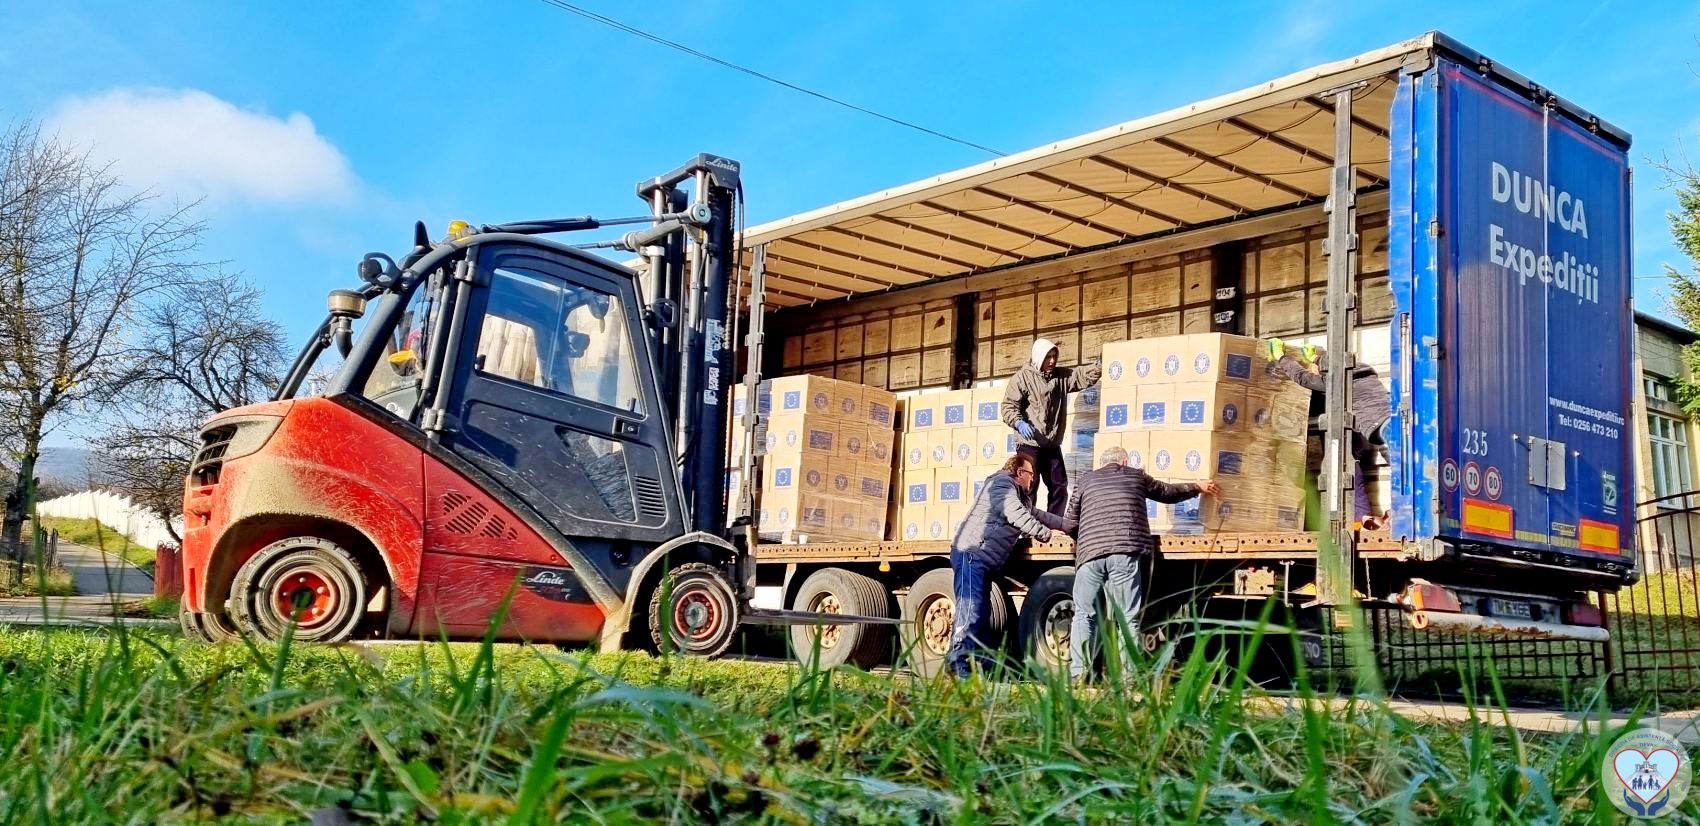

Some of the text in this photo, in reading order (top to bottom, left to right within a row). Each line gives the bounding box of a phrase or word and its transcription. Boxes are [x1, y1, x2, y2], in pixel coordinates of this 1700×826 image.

[705, 158, 738, 172] Linde
[1491, 161, 1588, 239] DUNCA
[1558, 413, 1619, 440] Tel: 0256 473 210
[1463, 427, 1488, 457] 235
[1445, 467, 1455, 481] 60
[1468, 472, 1478, 486] 70
[1488, 476, 1498, 490] 80
[526, 570, 566, 585] Linde
